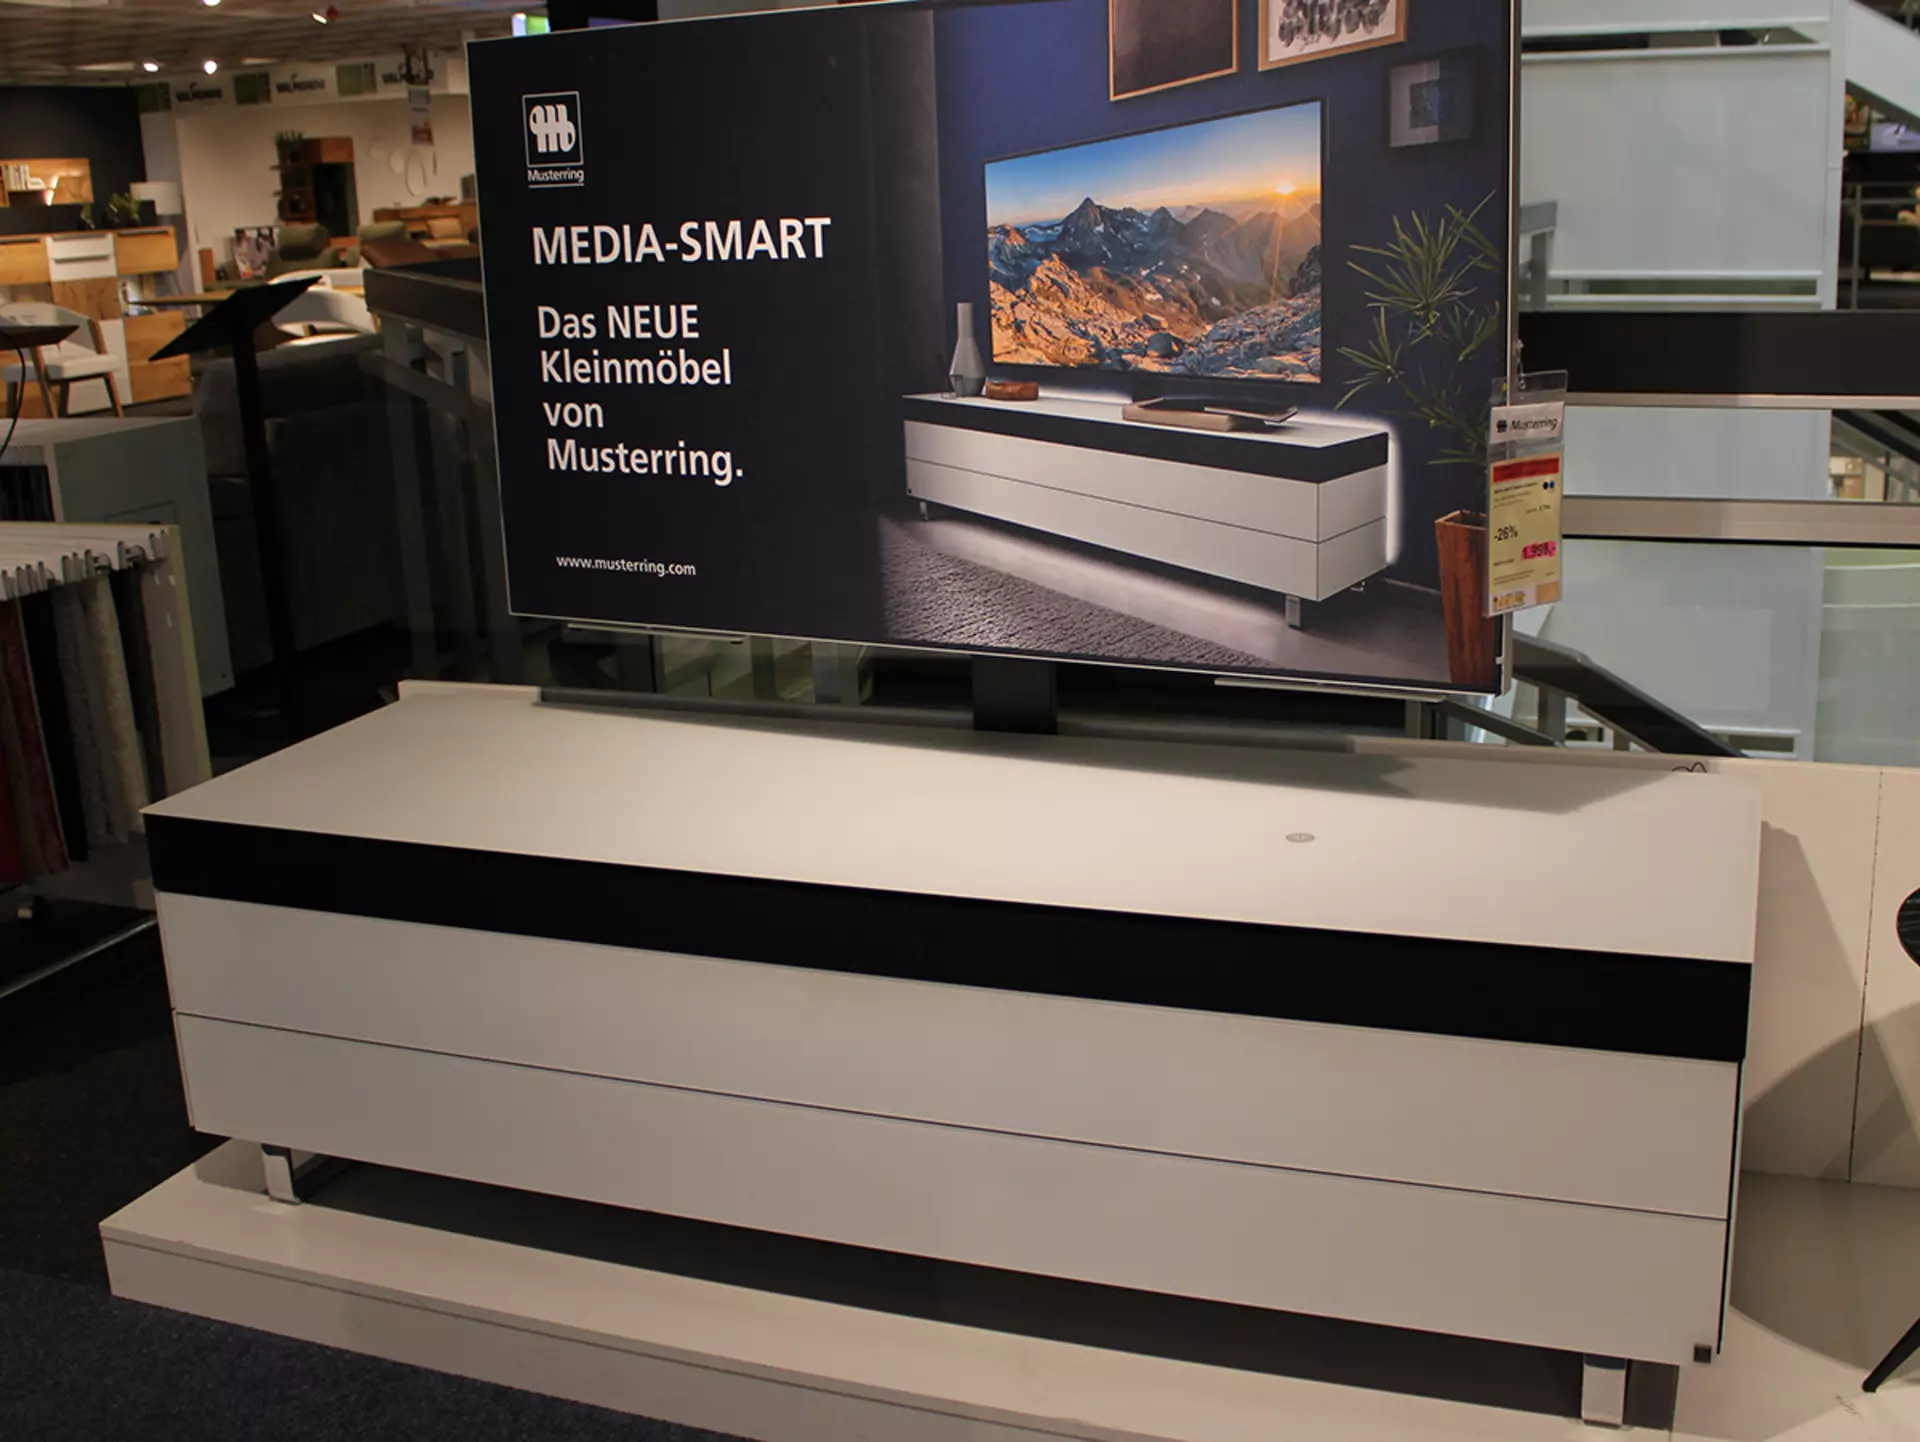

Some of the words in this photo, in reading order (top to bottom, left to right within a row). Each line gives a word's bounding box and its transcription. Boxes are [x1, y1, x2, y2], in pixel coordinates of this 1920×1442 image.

[527, 167, 585, 184] Musterring
[533, 219, 831, 264] MEDIA-SMART
[537, 305, 597, 340] Das
[607, 304, 700, 340] NEUE
[540, 348, 732, 386] Kleinmöbel
[543, 401, 605, 429] von
[1509, 415, 1558, 432] Musterring
[546, 438, 744, 487] Musterring.
[1494, 525, 1518, 541] -26%
[556, 554, 697, 577] www.musterring.com
